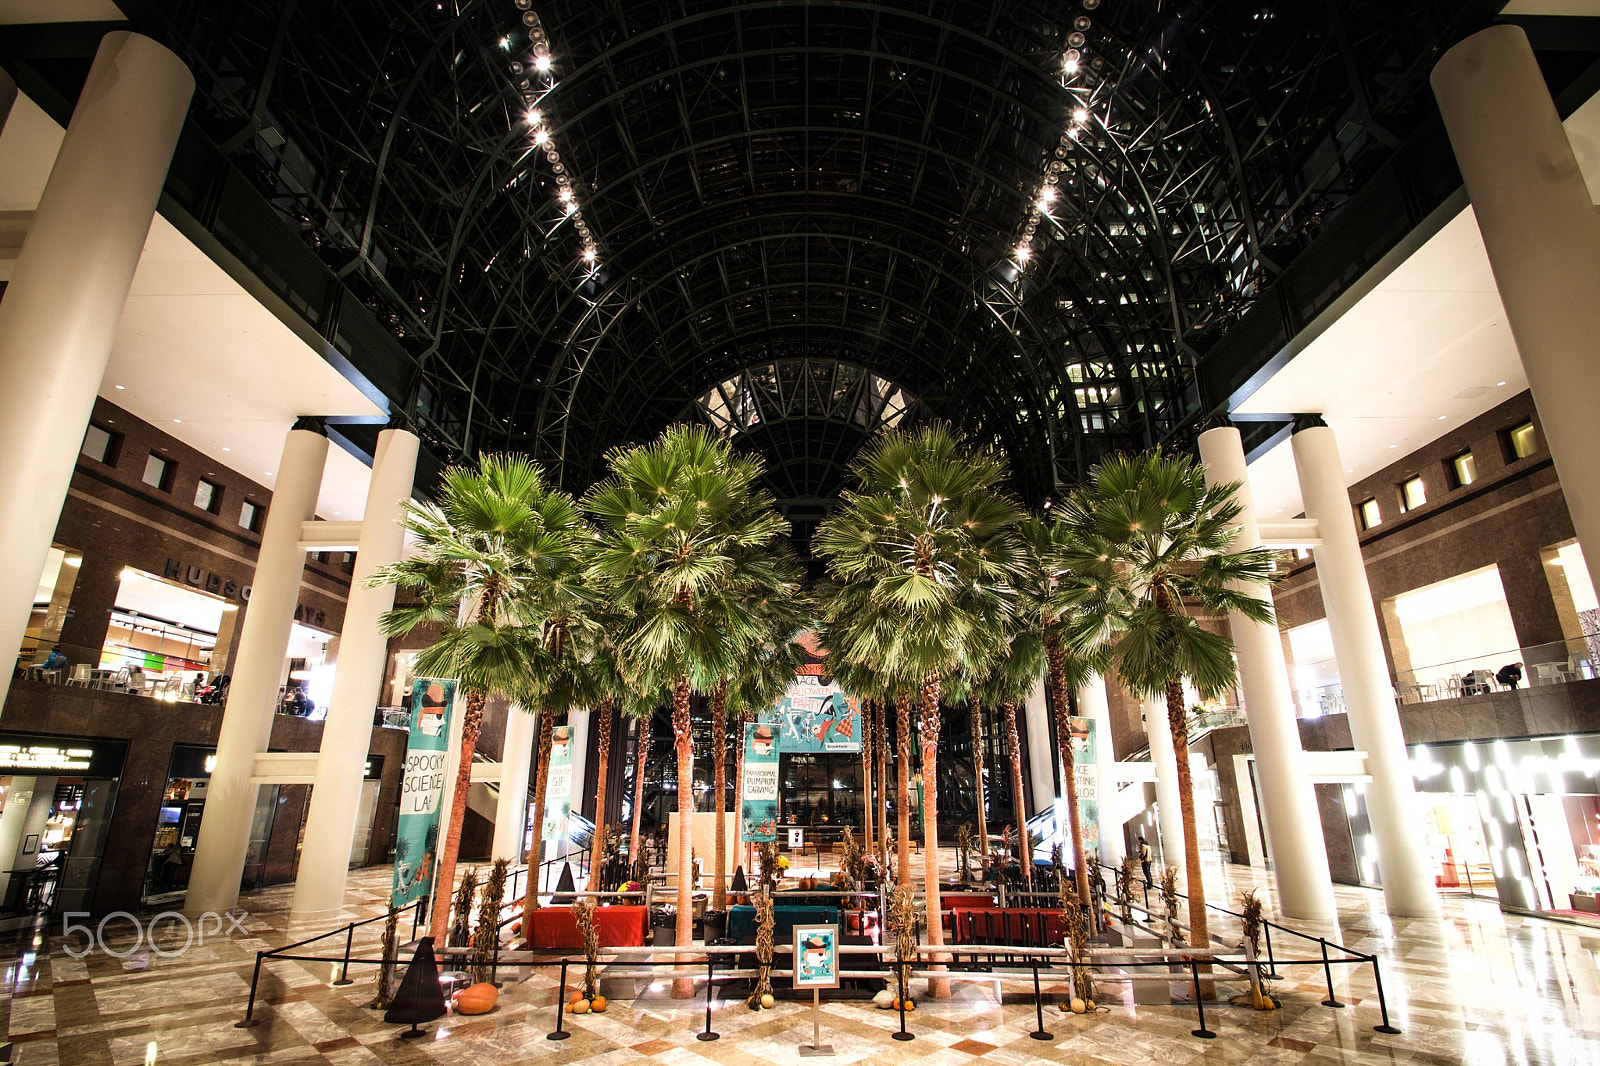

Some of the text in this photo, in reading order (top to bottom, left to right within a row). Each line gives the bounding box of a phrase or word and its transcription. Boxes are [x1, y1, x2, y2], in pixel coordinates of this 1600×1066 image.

[164, 557, 326, 626] HUDSO ATS
[790, 686, 832, 698] ALLOWEEN
[792, 697, 822, 712] PARTY
[404, 773, 443, 793] SCIENCE
[747, 777, 776, 785] PUMPKIN
[747, 786, 775, 794] CARVING
